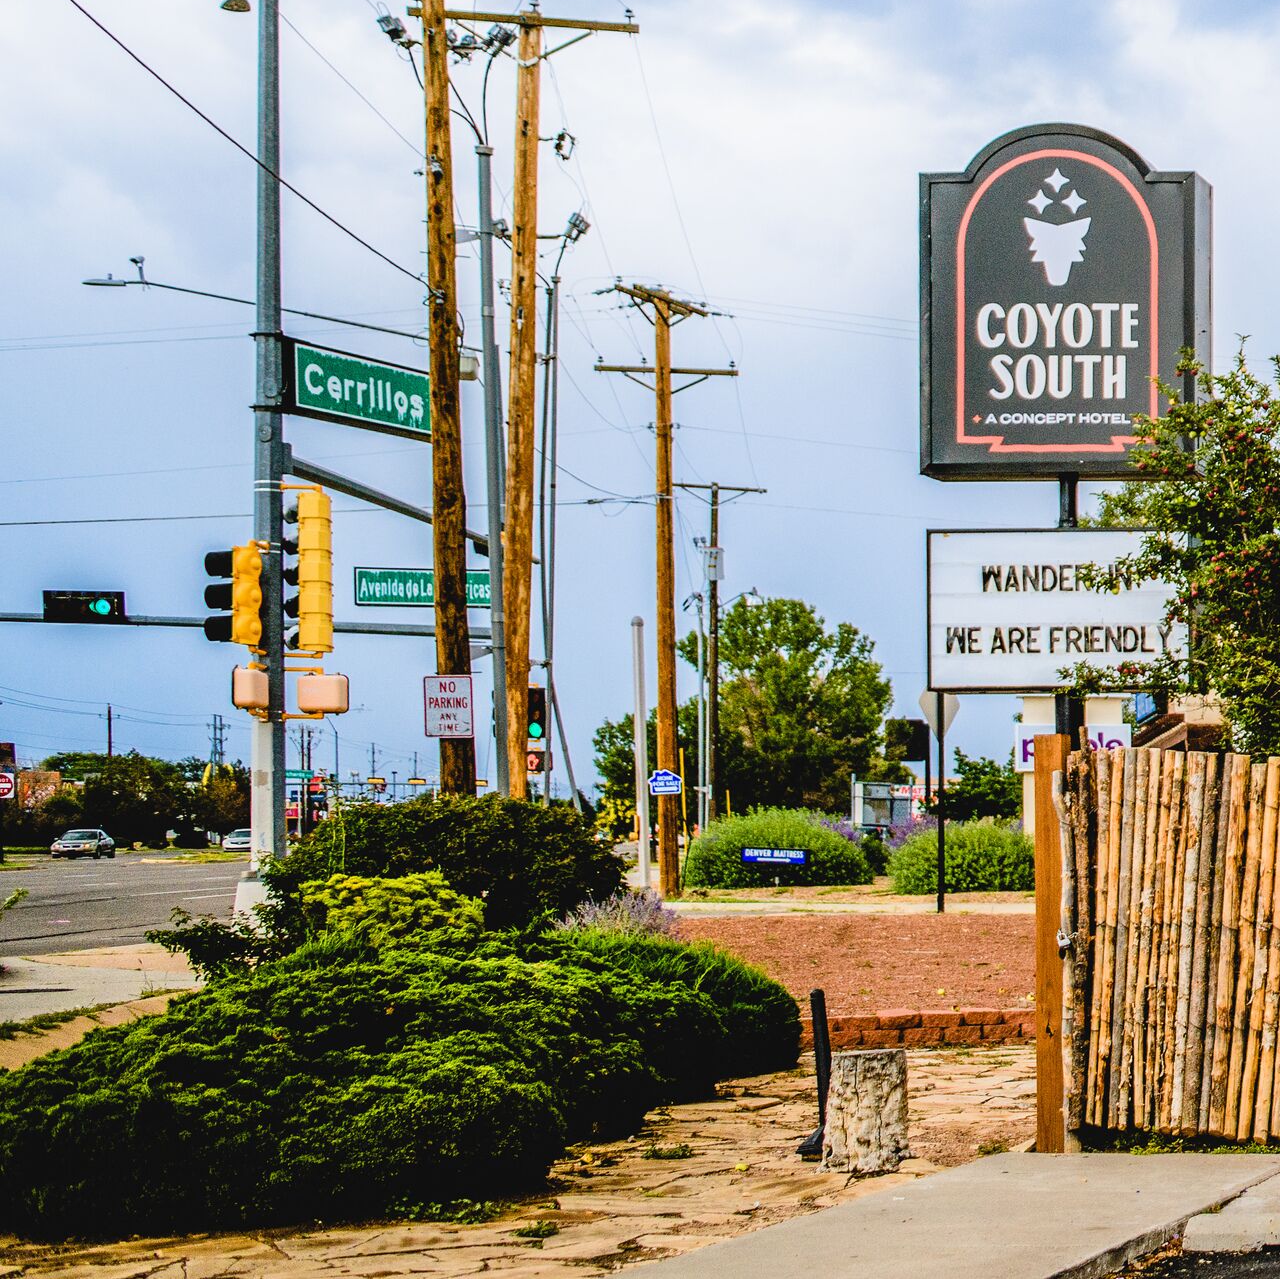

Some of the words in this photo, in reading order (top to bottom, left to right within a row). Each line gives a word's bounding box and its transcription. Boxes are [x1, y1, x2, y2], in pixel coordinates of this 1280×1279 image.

[976, 302, 1139, 349] COYOTE
[988, 353, 1127, 400] SOUTH
[304, 363, 424, 423] Cerrillos
[985, 413, 998, 424] A
[999, 412, 1077, 425] CONCEPT
[1078, 412, 1132, 425] HOTEL
[360, 577, 404, 598] Avenida
[405, 579, 419, 599] de
[420, 578, 433, 597] La
[946, 625, 983, 654] WE
[990, 625, 1041, 654] ARE
[1048, 625, 1173, 654] FRIENDLY
[439, 681, 456, 693] NO
[428, 696, 468, 709] PARKING
[440, 713, 458, 721] ANY
[438, 723, 460, 732] TIME
[744, 848, 772, 857] DENVER
[773, 849, 804, 859] MATTRESS
